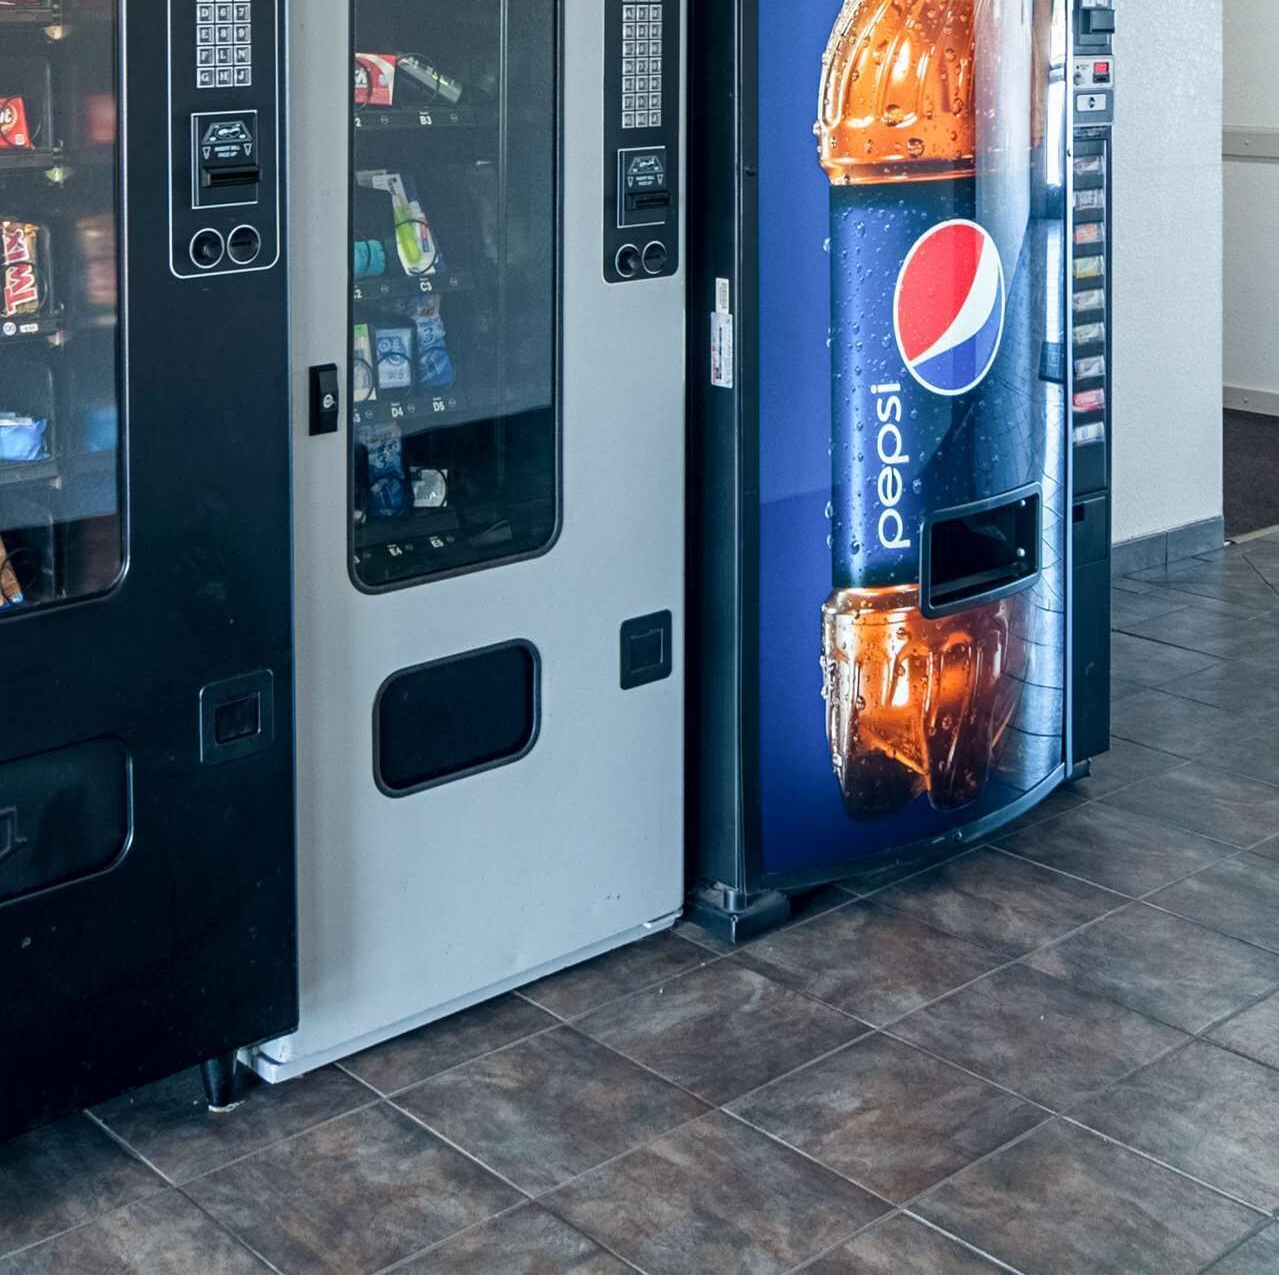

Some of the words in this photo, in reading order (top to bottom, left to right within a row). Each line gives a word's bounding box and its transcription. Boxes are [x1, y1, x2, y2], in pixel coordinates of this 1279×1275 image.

[391, 405, 404, 417] D4
[432, 400, 445, 412] D5
[871, 382, 910, 549] pepsi
